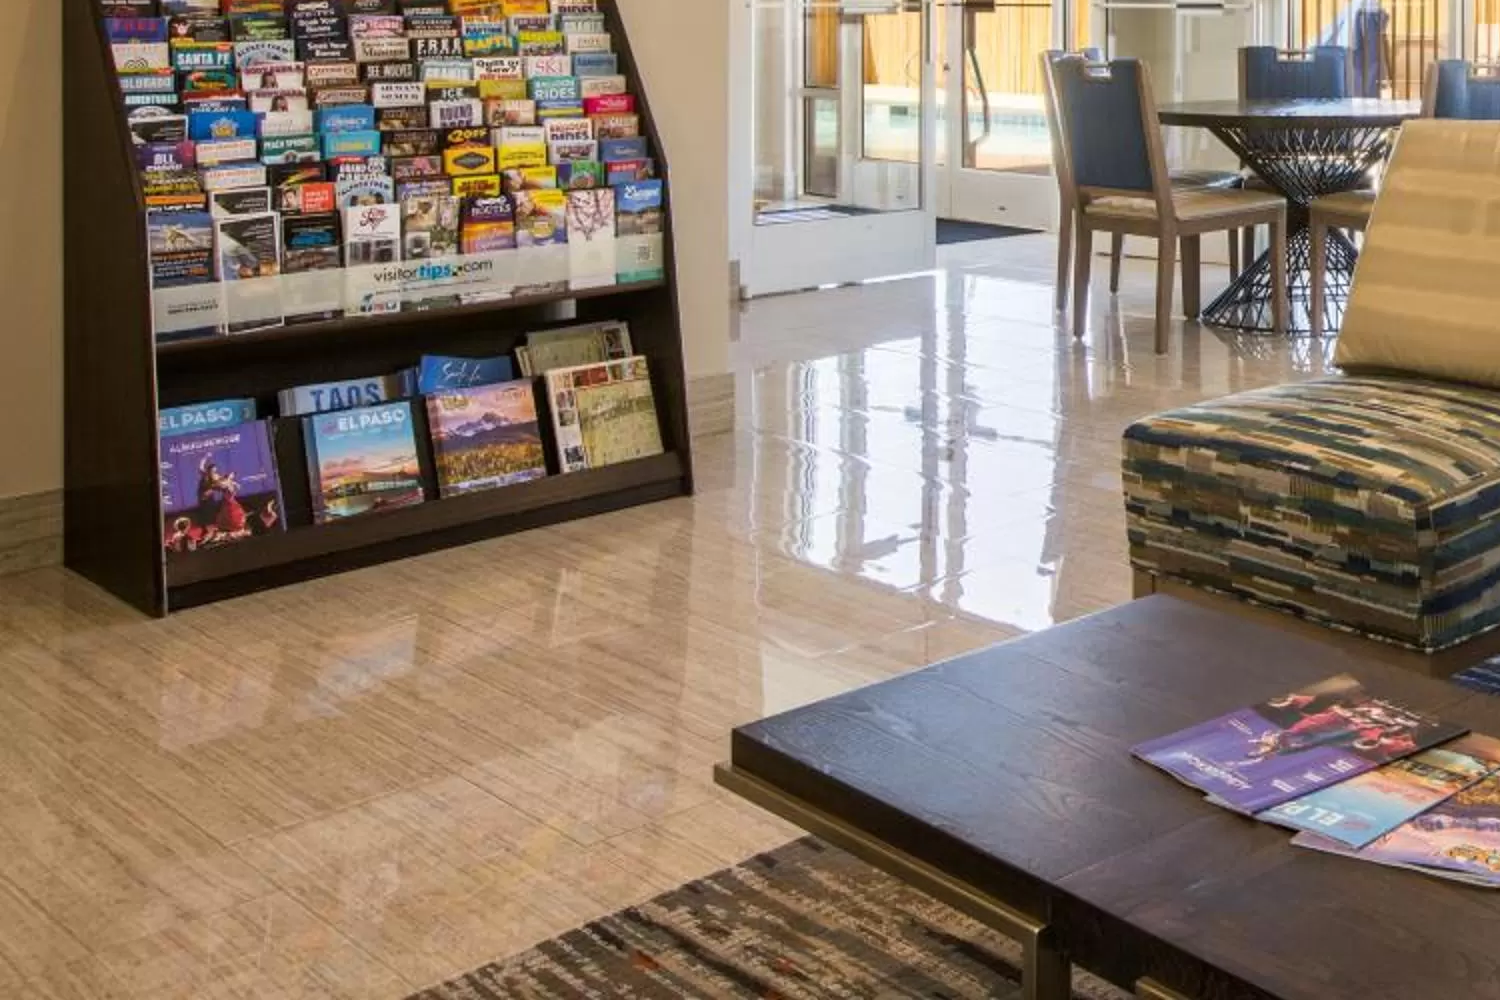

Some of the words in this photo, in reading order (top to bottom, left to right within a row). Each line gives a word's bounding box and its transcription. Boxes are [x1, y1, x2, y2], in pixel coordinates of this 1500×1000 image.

[177, 53, 213, 66] SANTA
[217, 53, 231, 65] FE
[535, 88, 577, 99] RIDES
[310, 383, 380, 411] TAOS
[160, 415, 178, 429] EL
[180, 407, 233, 427] PASO
[338, 416, 359, 431] EL
[360, 409, 406, 429] PASO
